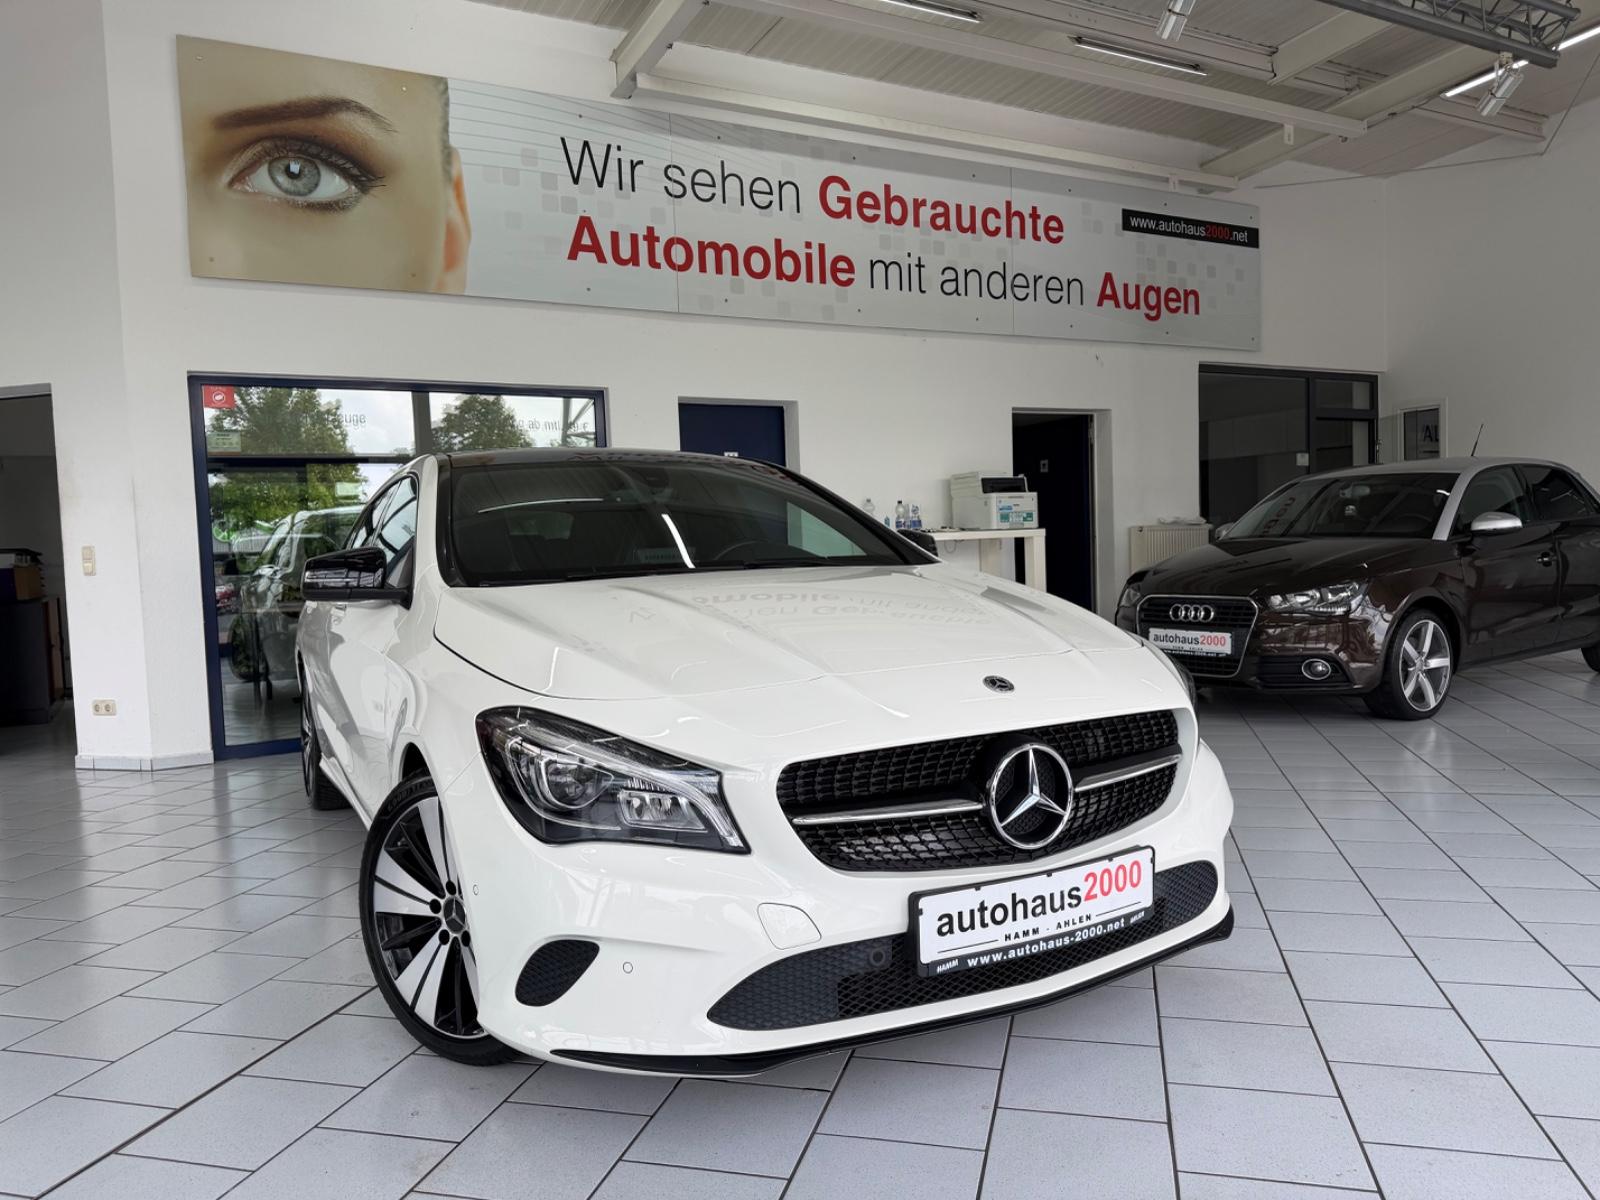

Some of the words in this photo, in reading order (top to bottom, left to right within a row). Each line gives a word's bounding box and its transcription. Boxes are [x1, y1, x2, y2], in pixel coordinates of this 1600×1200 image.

[560, 137, 644, 192] Wir
[663, 160, 800, 213] sehen
[819, 175, 1064, 244] Gebrauchte
[1129, 216, 1248, 242] www.autohaus2000.net
[567, 215, 855, 287] Automobile
[869, 252, 926, 295] mit
[940, 262, 1084, 305] anderen
[1097, 272, 1200, 322] Augen
[1153, 633, 1227, 647] autohaus2000
[936, 859, 1142, 937] autohaus2000
[936, 958, 959, 974] HAMM
[967, 917, 1125, 967] www.autohaus-2000.net
[1004, 927, 1040, 941] HAMM
[1056, 913, 1092, 930] AHLEN
